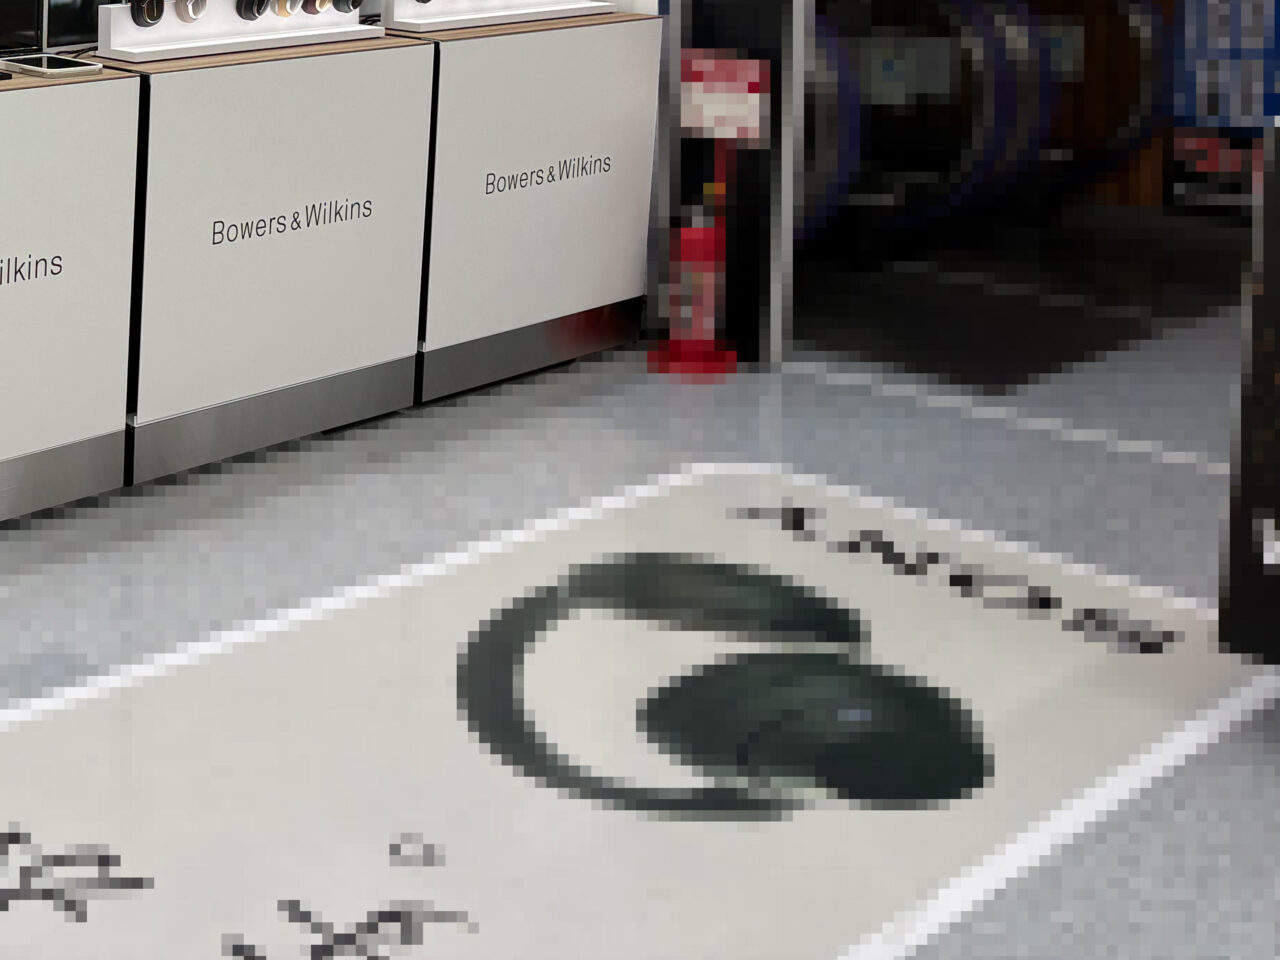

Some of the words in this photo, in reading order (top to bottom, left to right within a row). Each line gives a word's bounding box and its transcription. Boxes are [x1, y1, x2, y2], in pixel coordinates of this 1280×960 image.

[485, 169, 544, 195] Bowers
[546, 165, 556, 183] &
[558, 154, 611, 181] Wilkins
[212, 215, 287, 246] Bowers
[290, 211, 302, 231] &
[305, 198, 372, 228] Wilkins
